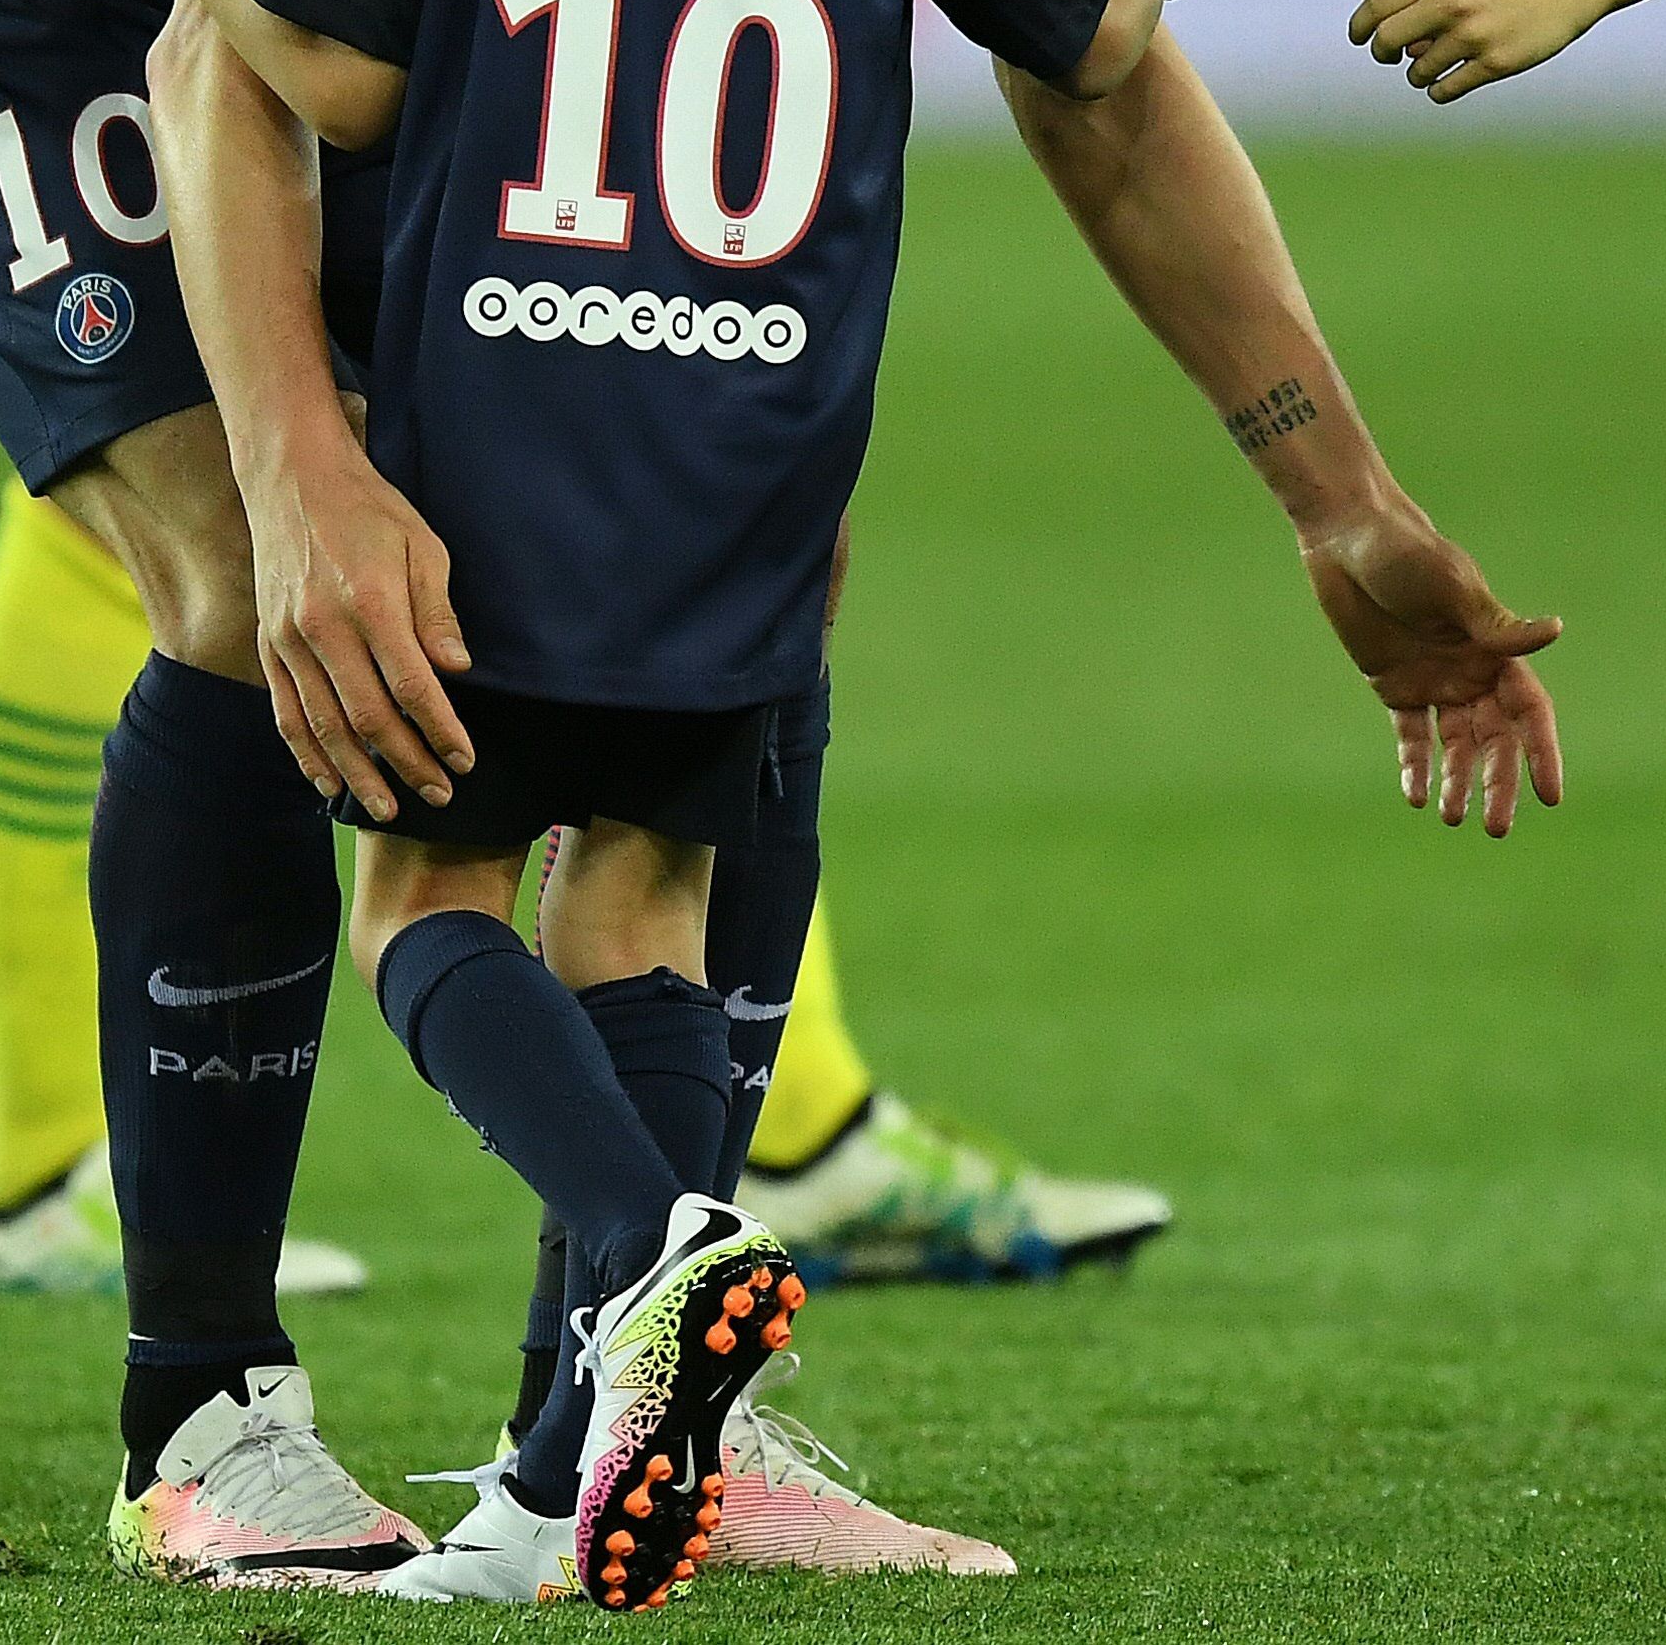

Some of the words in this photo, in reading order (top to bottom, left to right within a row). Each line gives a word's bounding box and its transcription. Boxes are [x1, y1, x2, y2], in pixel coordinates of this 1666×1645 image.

[63, 278, 112, 309] PARIS
[463, 277, 807, 364] ooredoo
[149, 1041, 316, 1082] PARIS
